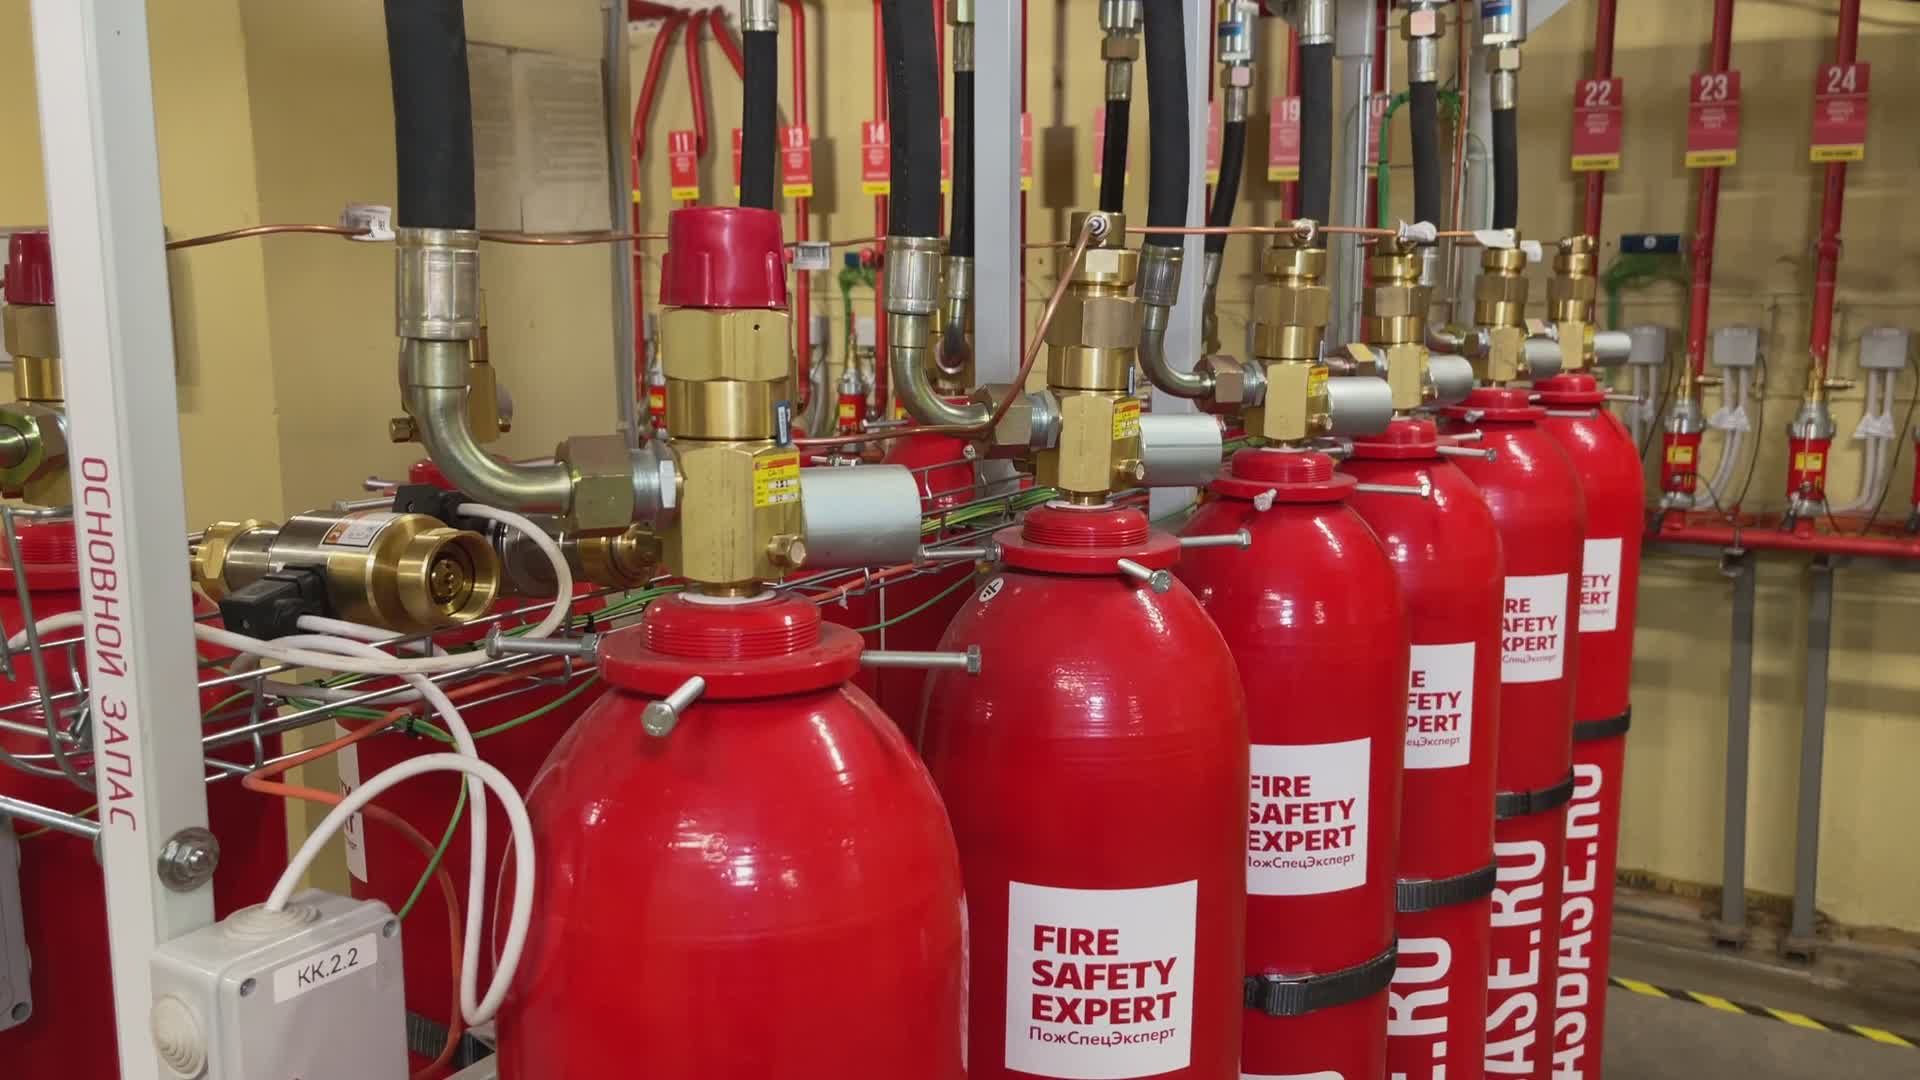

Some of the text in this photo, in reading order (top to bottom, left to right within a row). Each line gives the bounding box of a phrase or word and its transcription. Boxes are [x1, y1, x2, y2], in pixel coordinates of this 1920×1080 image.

[1700, 73, 1728, 101] 23
[1827, 65, 1857, 93] 24
[1584, 81, 1611, 107] 22
[1281, 99, 1300, 121] 19
[675, 132, 689, 153] 11
[788, 127, 804, 147] 13
[869, 123, 886, 145] 14
[1504, 597, 1531, 614] RE
[1581, 591, 1611, 606] ERT
[1502, 615, 1558, 633] AFETY
[81, 457, 137, 832] ОСНОВНОЙ ЗАПАС
[1502, 634, 1558, 652] XPERT
[1408, 690, 1462, 711] FETY
[1406, 713, 1462, 733] PERT
[1406, 737, 1460, 747] ецЭксперт
[1249, 797, 1356, 825] SAFETY
[1248, 824, 1356, 853] EXPERT
[1033, 924, 1119, 956] FIRE
[1483, 840, 1546, 1080] ASE.RU
[1031, 956, 1178, 991] SAFETY
[1031, 991, 1177, 1026] EXPERT
[1029, 1025, 1176, 1048] ПожСпецЭксперт
